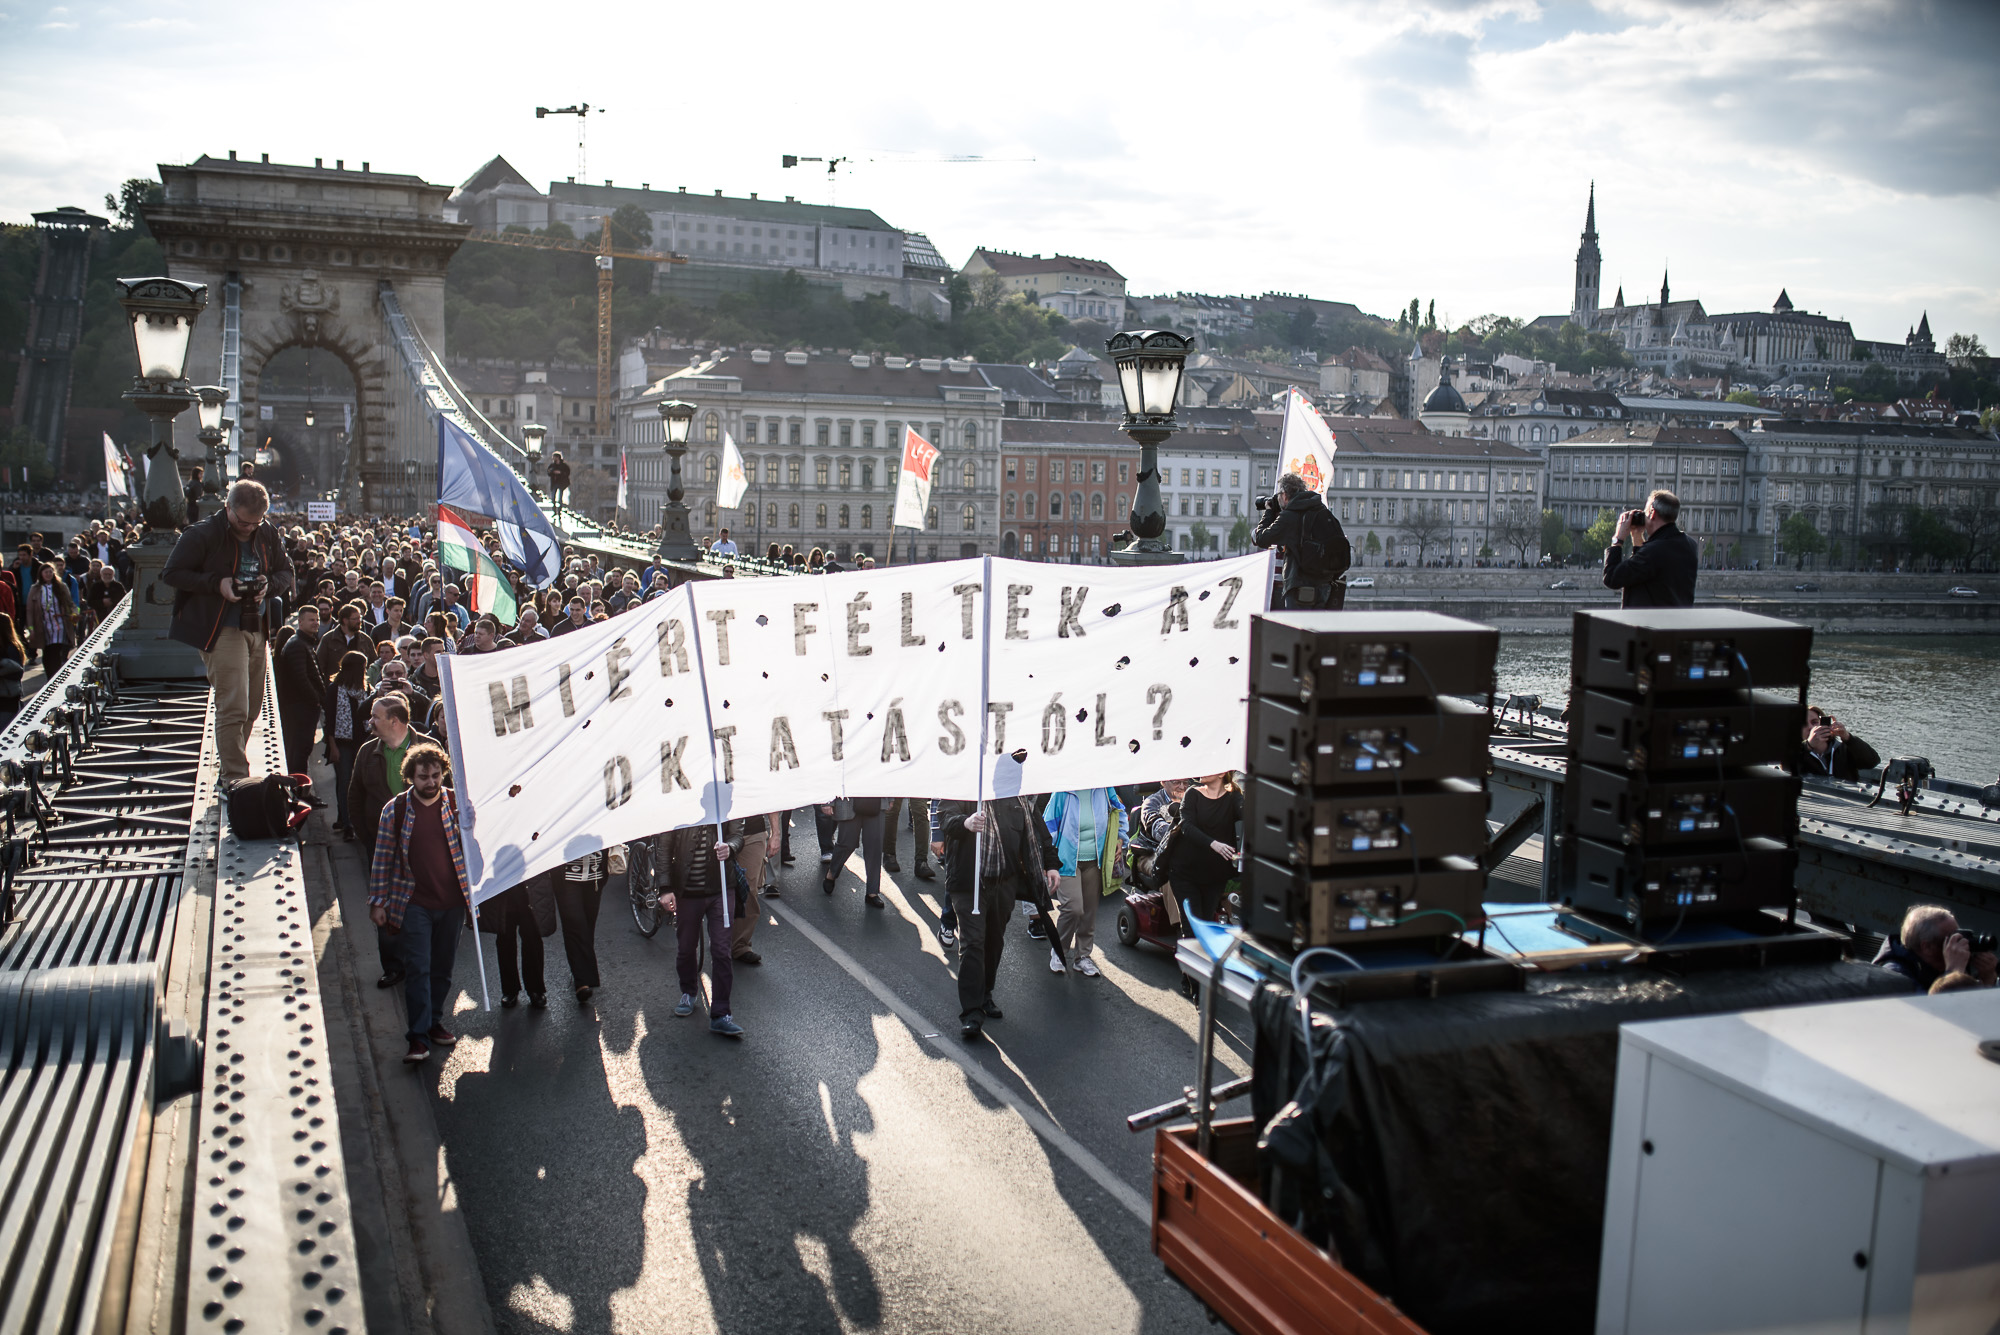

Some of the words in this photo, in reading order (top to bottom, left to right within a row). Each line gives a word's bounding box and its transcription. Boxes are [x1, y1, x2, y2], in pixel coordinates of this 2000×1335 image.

[488, 609, 736, 737] MIÉRT
[793, 582, 1089, 657] FÉLTEK
[1160, 576, 1243, 635] AZ
[603, 683, 1173, 811] OKTATÁSTÓL?
